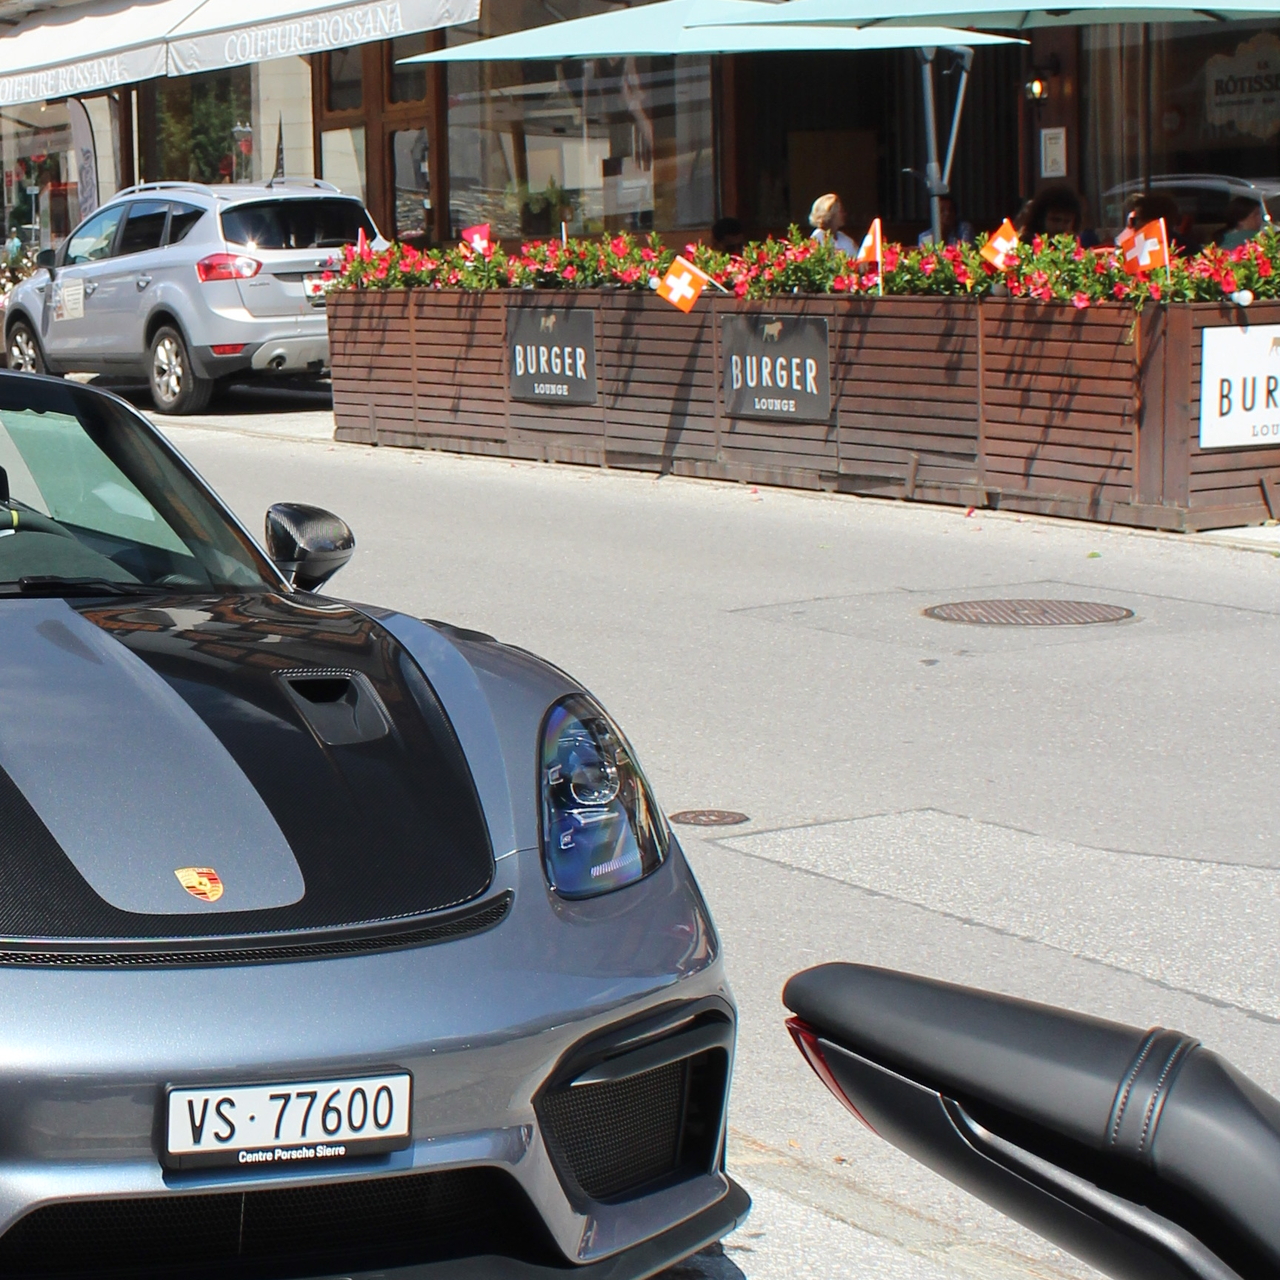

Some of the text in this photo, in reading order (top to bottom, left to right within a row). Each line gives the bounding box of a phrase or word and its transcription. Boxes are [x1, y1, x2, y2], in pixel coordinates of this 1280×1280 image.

[225, 2, 404, 63] COIFFURE ROSSANA
[58, 56, 121, 93] ROSSANA
[514, 345, 587, 380] BURGER
[731, 355, 818, 394] BURGER
[534, 383, 568, 396] LOUNGE
[754, 397, 795, 412] LOUNGE
[1219, 375, 1278, 418] BUR
[1252, 424, 1280, 437] LOU
[238, 1144, 346, 1163] Centre Porsche Sierre
